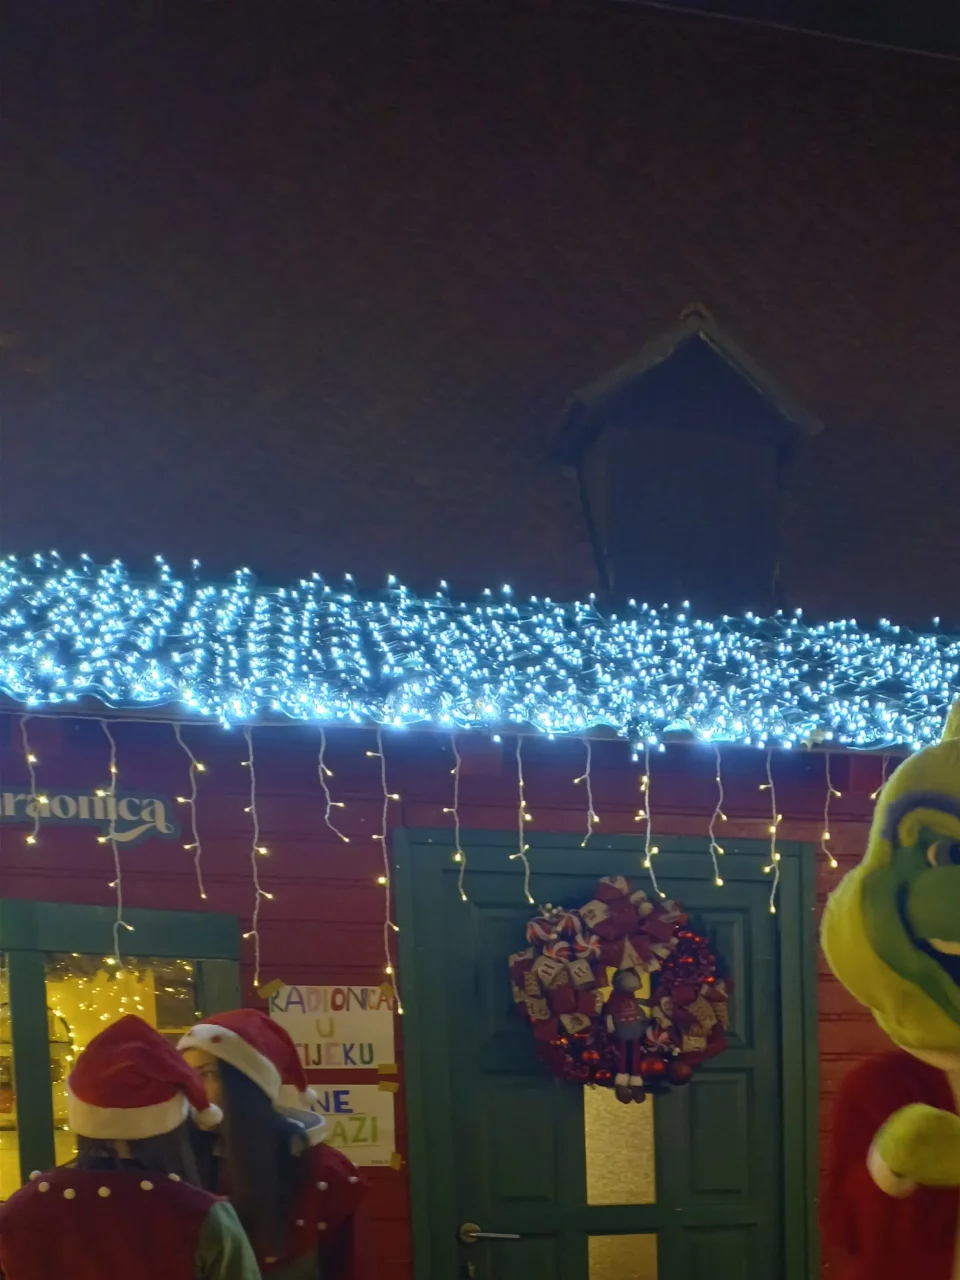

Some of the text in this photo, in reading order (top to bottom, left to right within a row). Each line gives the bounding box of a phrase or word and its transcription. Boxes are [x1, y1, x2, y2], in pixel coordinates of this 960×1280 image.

[0, 789, 174, 842] raonica
[315, 1017, 334, 1038] U
[296, 1043, 374, 1066] IJEKU
[324, 1117, 378, 1144] AZI
